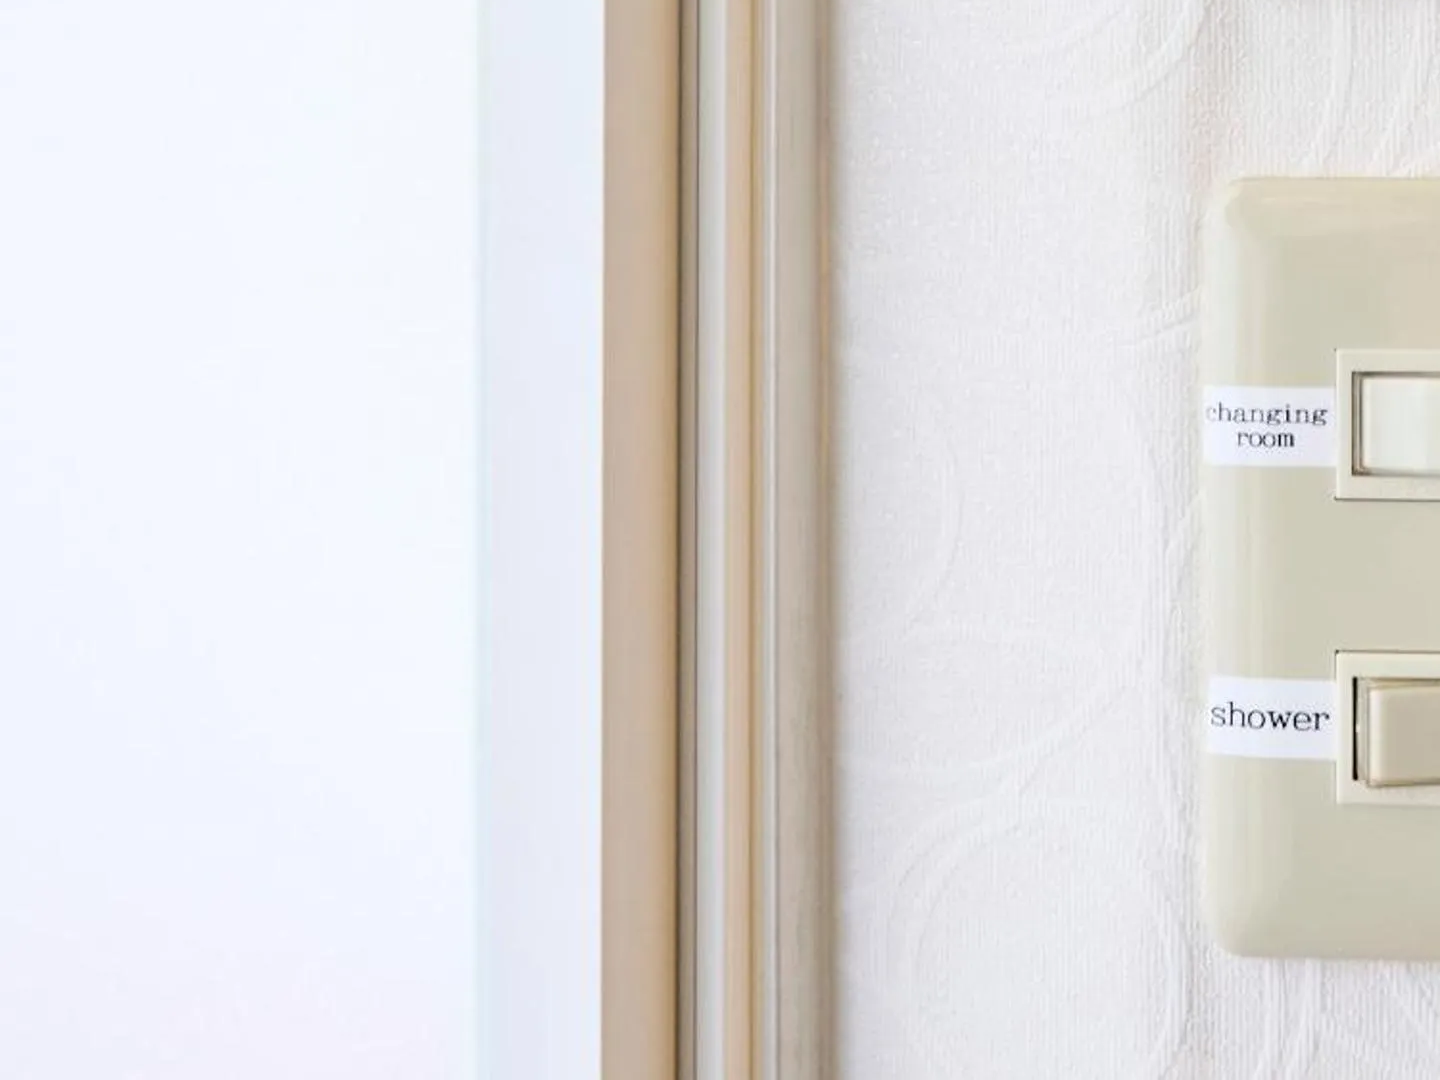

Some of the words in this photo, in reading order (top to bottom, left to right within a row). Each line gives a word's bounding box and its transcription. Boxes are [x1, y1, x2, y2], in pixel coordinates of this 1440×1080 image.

[1206, 400, 1328, 425] changing
[1237, 431, 1295, 448] room
[1210, 701, 1330, 732] shower
